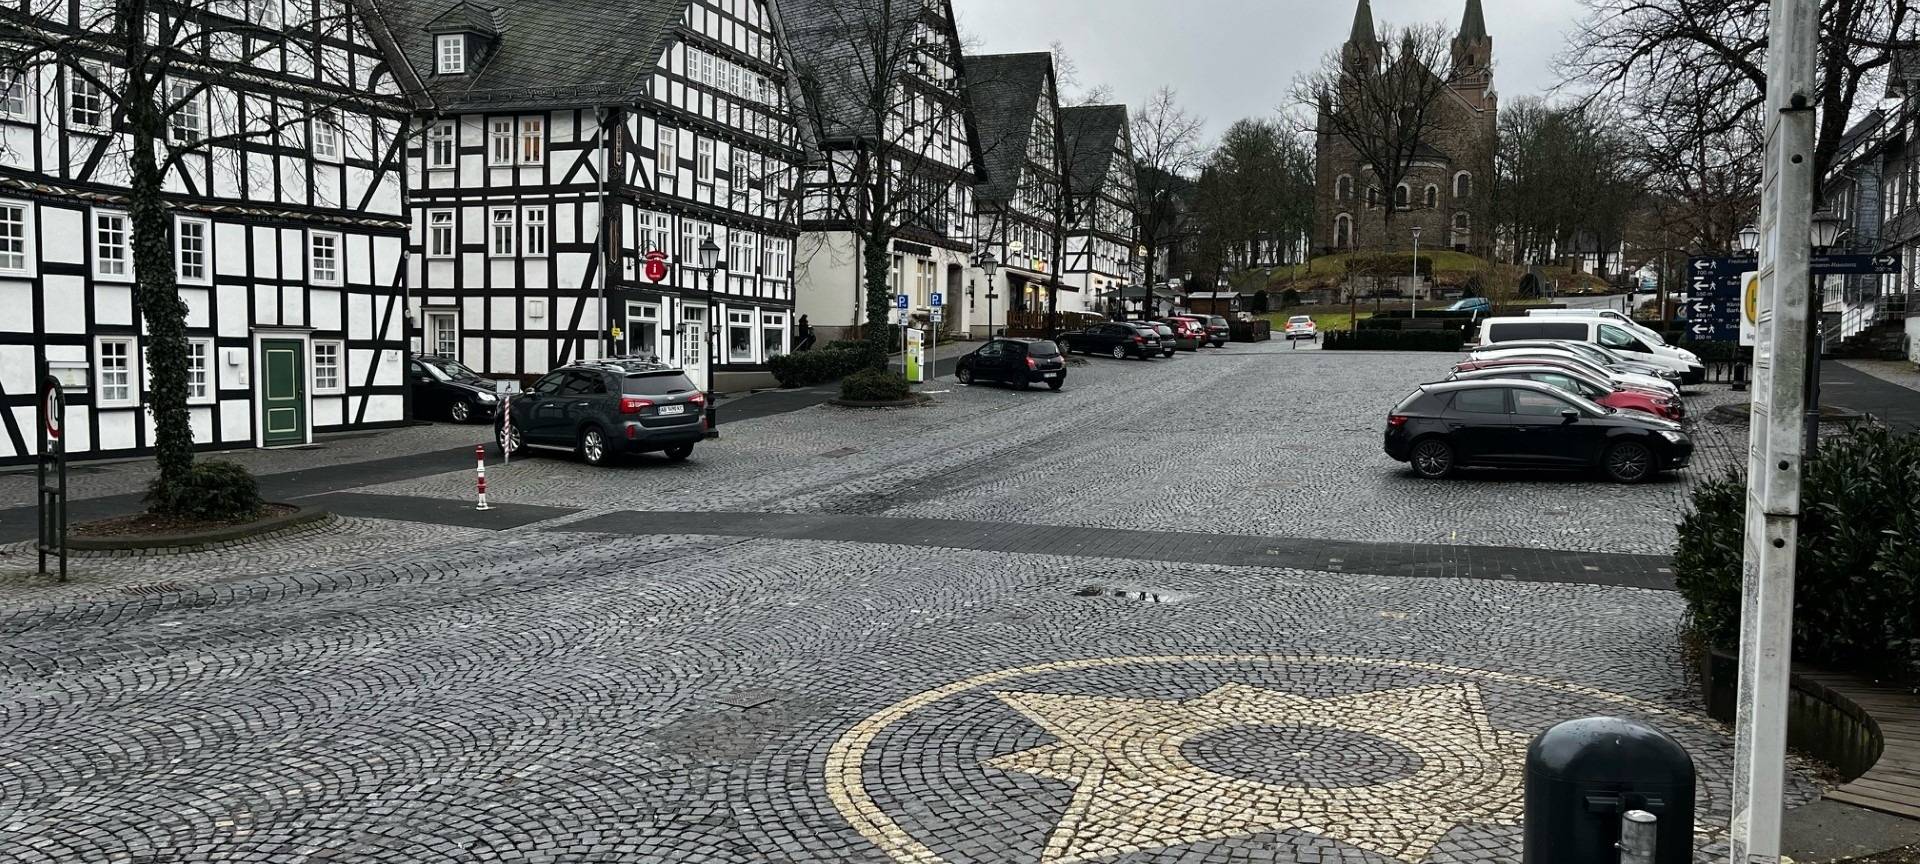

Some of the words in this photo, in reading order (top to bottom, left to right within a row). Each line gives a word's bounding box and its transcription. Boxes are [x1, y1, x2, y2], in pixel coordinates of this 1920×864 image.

[898, 296, 905, 307] P
[932, 295, 938, 304] P
[50, 395, 59, 421] 10
